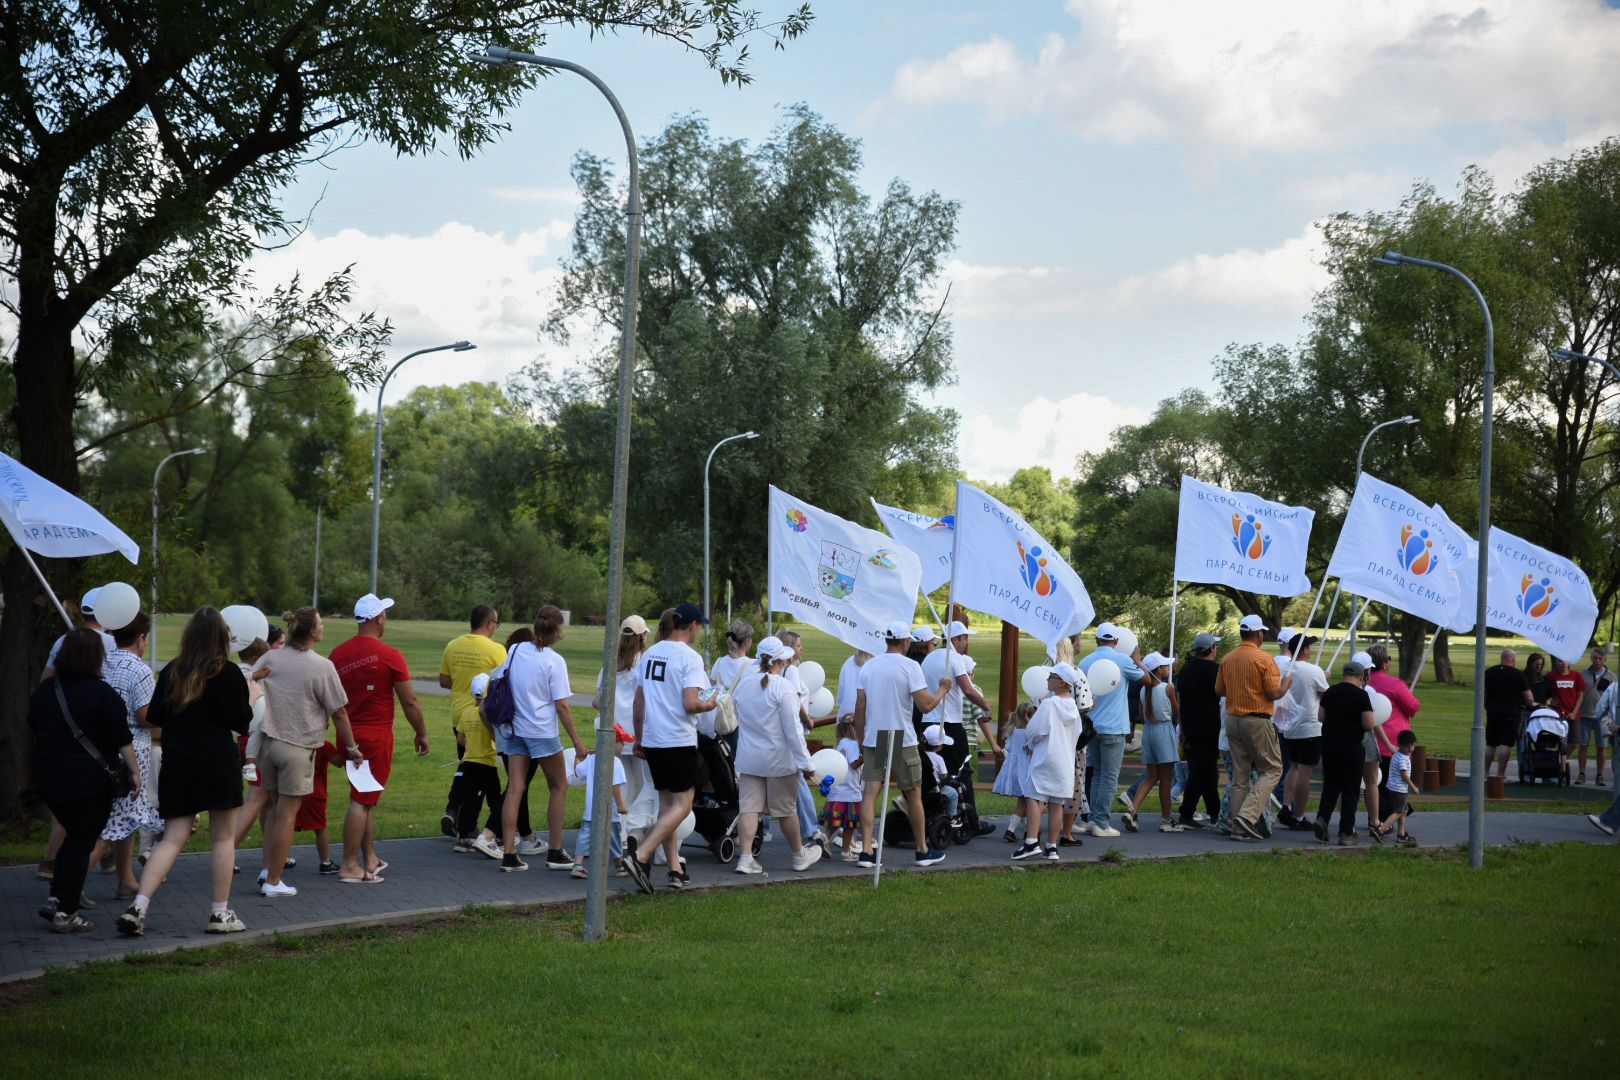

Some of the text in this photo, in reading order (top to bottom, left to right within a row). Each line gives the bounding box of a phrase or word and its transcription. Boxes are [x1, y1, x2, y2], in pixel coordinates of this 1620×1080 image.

[1206, 559, 1290, 583] ПАРАД СЕМЬИ
[1367, 561, 1406, 589] ПАРАД
[788, 592, 848, 624] СЕМЬЯ МОЯ
[988, 584, 1031, 613] ПАРАД
[1527, 622, 1565, 642] СЕМЬИ
[645, 659, 667, 682] 10
